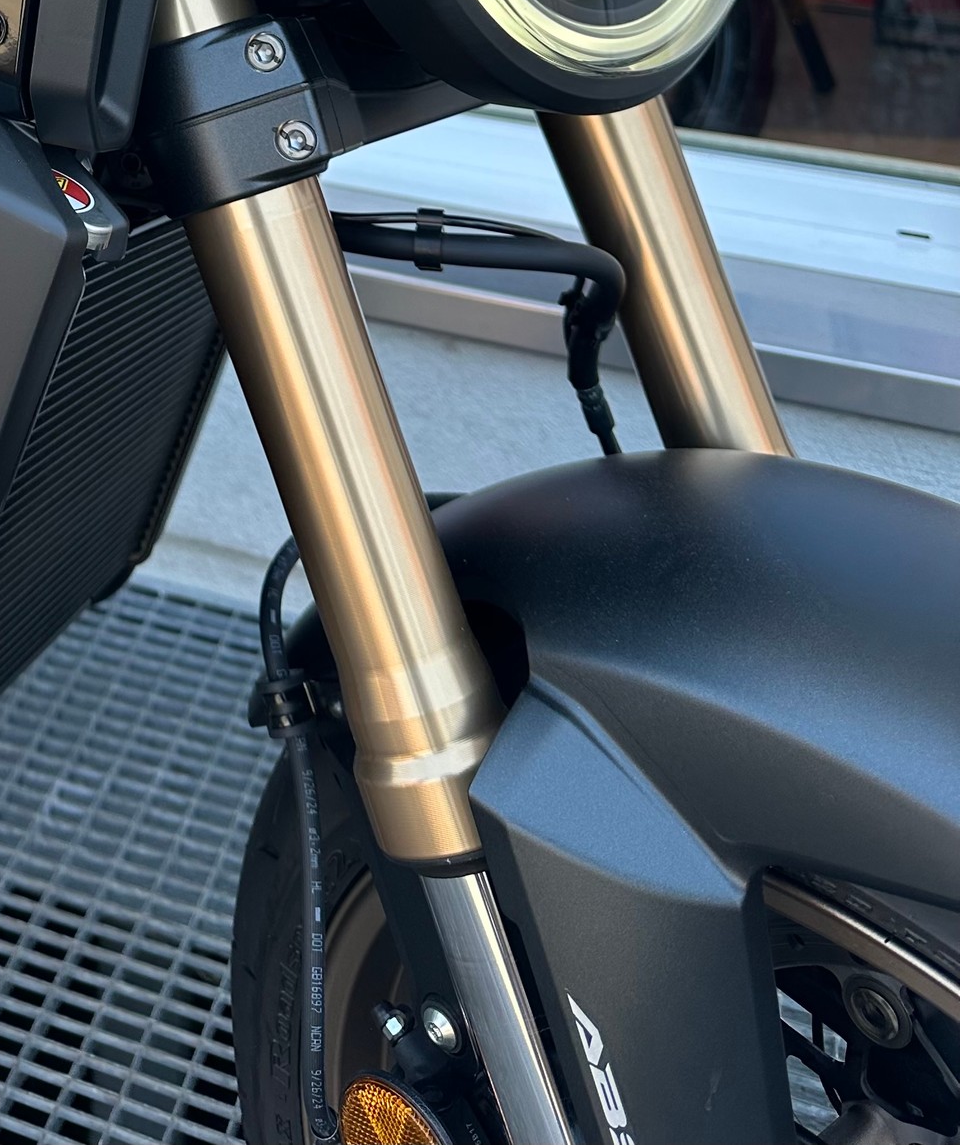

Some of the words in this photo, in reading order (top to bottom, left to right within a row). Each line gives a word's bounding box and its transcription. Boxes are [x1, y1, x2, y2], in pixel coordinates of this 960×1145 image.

[301, 770, 317, 815] 9/26/24
[311, 932, 323, 953] DOT
[311, 966, 323, 1014] GB16897
[310, 1069, 323, 1110] 9/26/24
